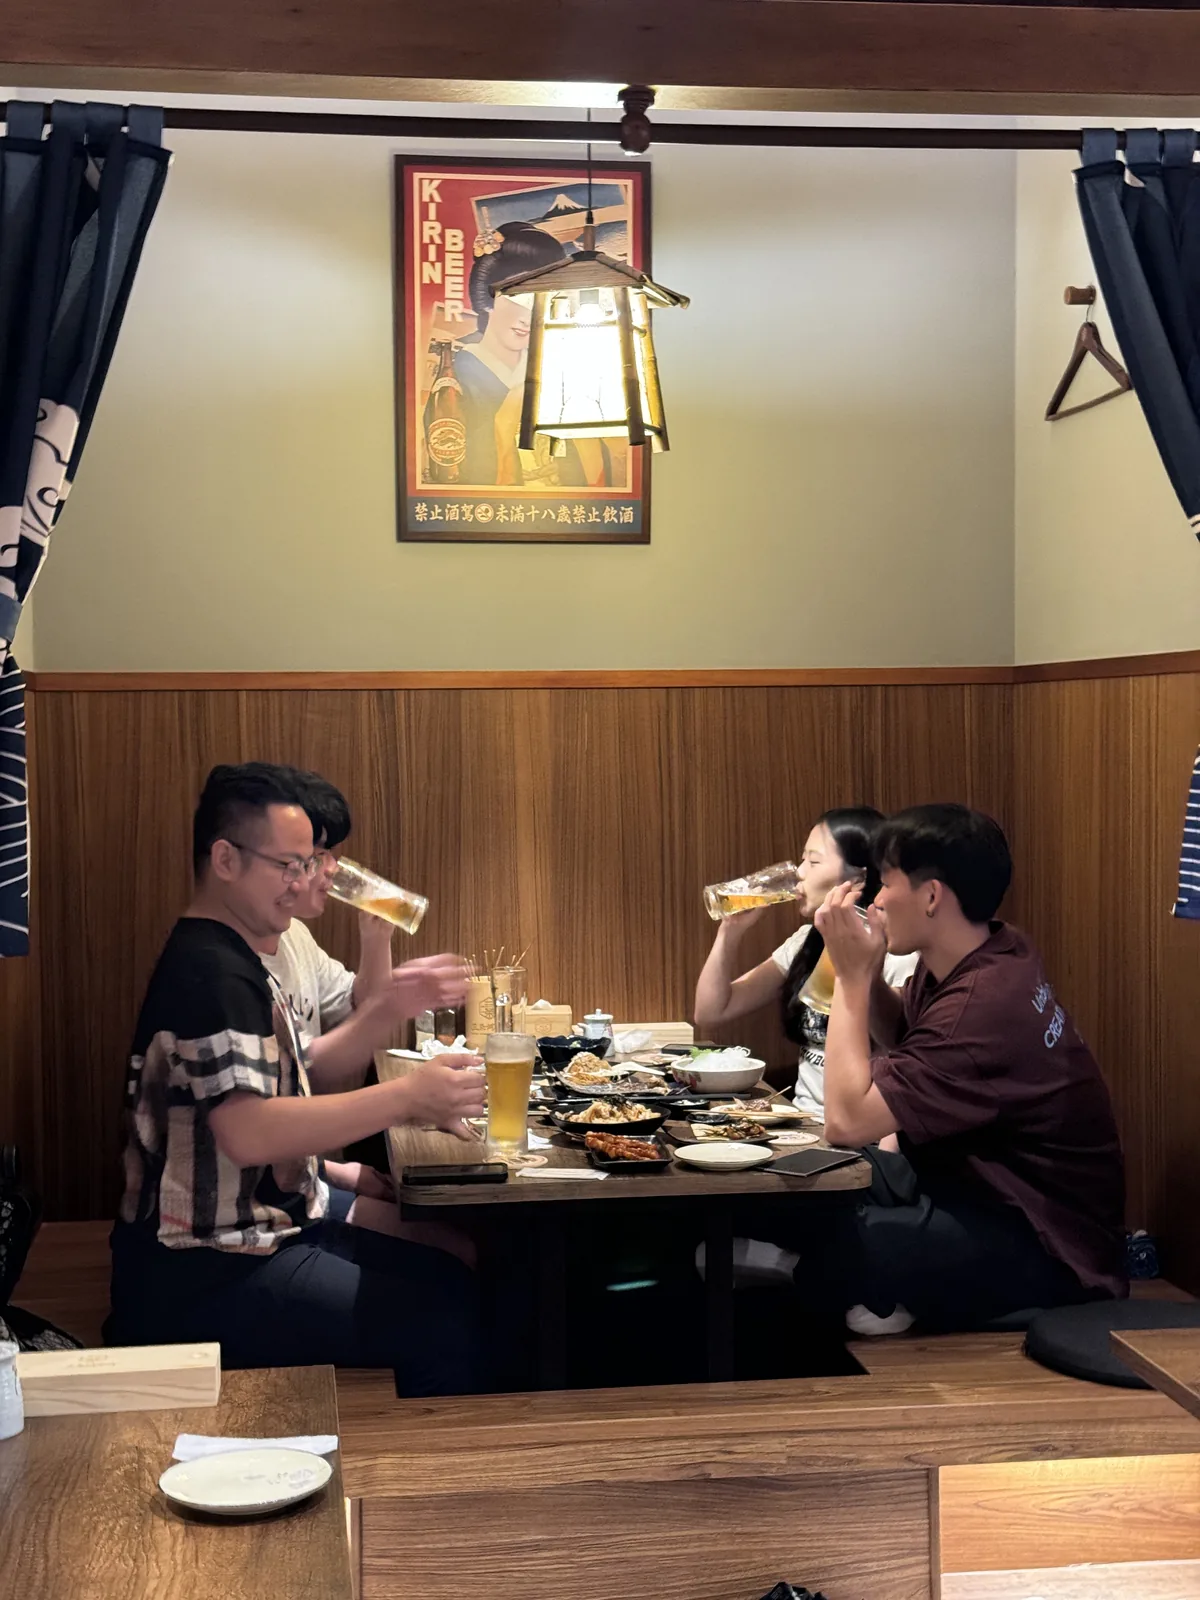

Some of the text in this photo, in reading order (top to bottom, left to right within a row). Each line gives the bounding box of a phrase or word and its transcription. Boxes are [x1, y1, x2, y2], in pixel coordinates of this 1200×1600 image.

[422, 179, 442, 284] KIRIN
[445, 229, 464, 322] BEER
[415, 502, 474, 522] 禁止酒駕
